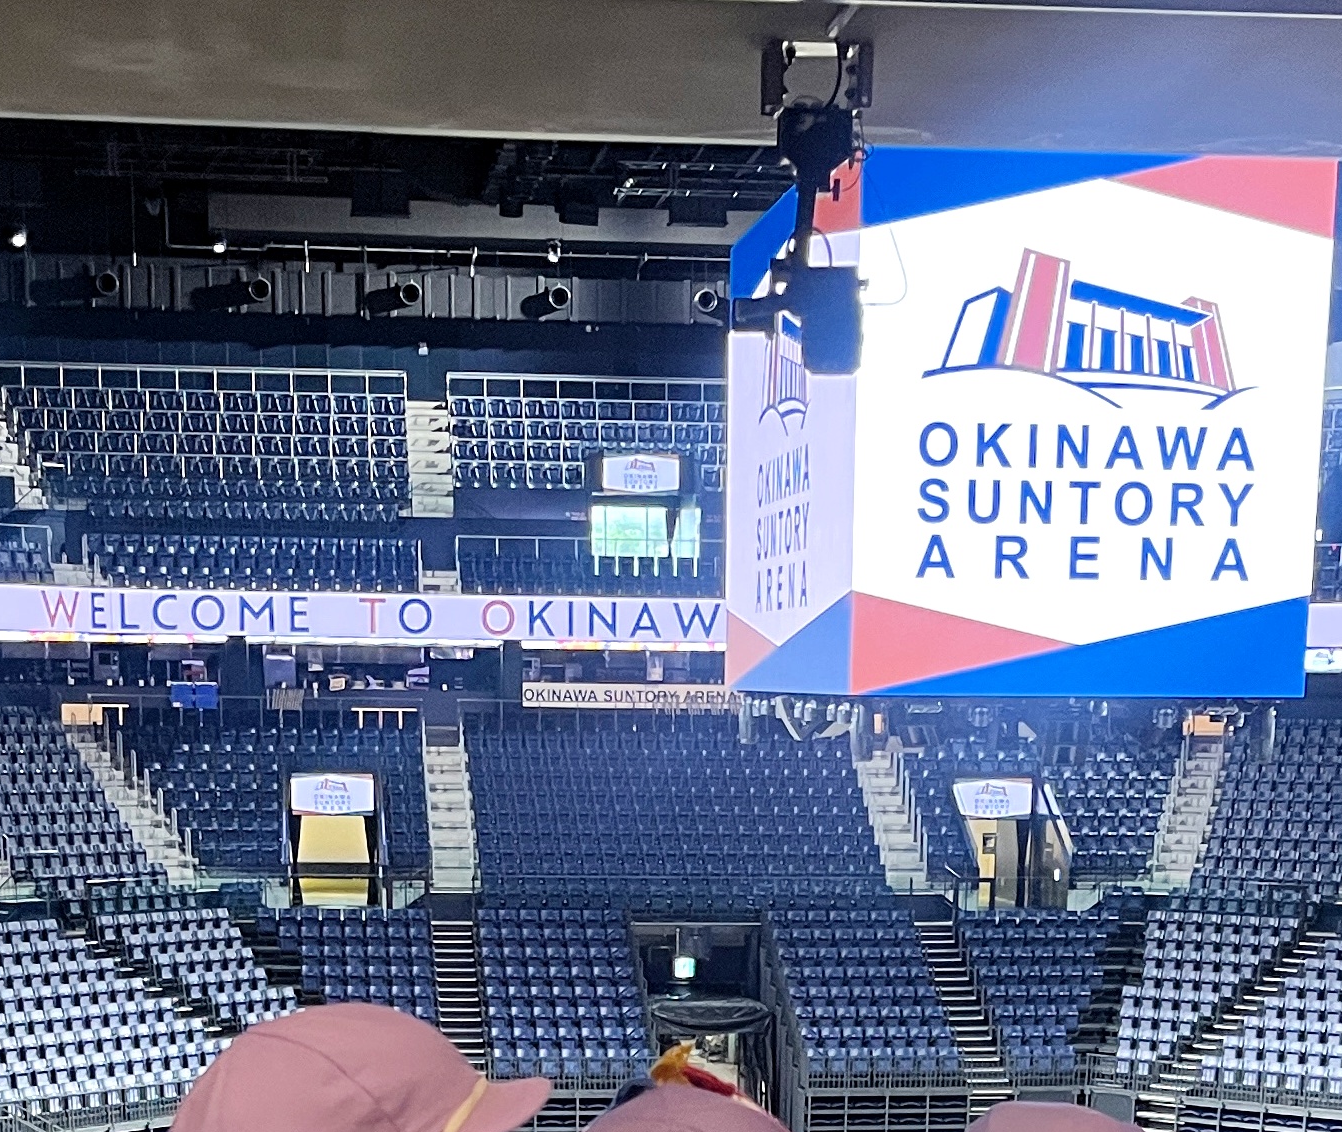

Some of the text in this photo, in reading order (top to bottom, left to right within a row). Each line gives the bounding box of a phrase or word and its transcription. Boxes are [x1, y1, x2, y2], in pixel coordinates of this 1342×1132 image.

[919, 421, 1255, 471] OKINAWA
[757, 444, 810, 507] OKINAWA
[917, 478, 1255, 527] SUNTORY
[756, 502, 810, 561] SUNTORY
[915, 534, 1249, 581] ARENA
[755, 561, 808, 613] ARENA
[41, 590, 721, 638] WELCOME TO OKINAW
[523, 688, 598, 702] OKINAWA
[603, 689, 677, 704] SUNTORY
